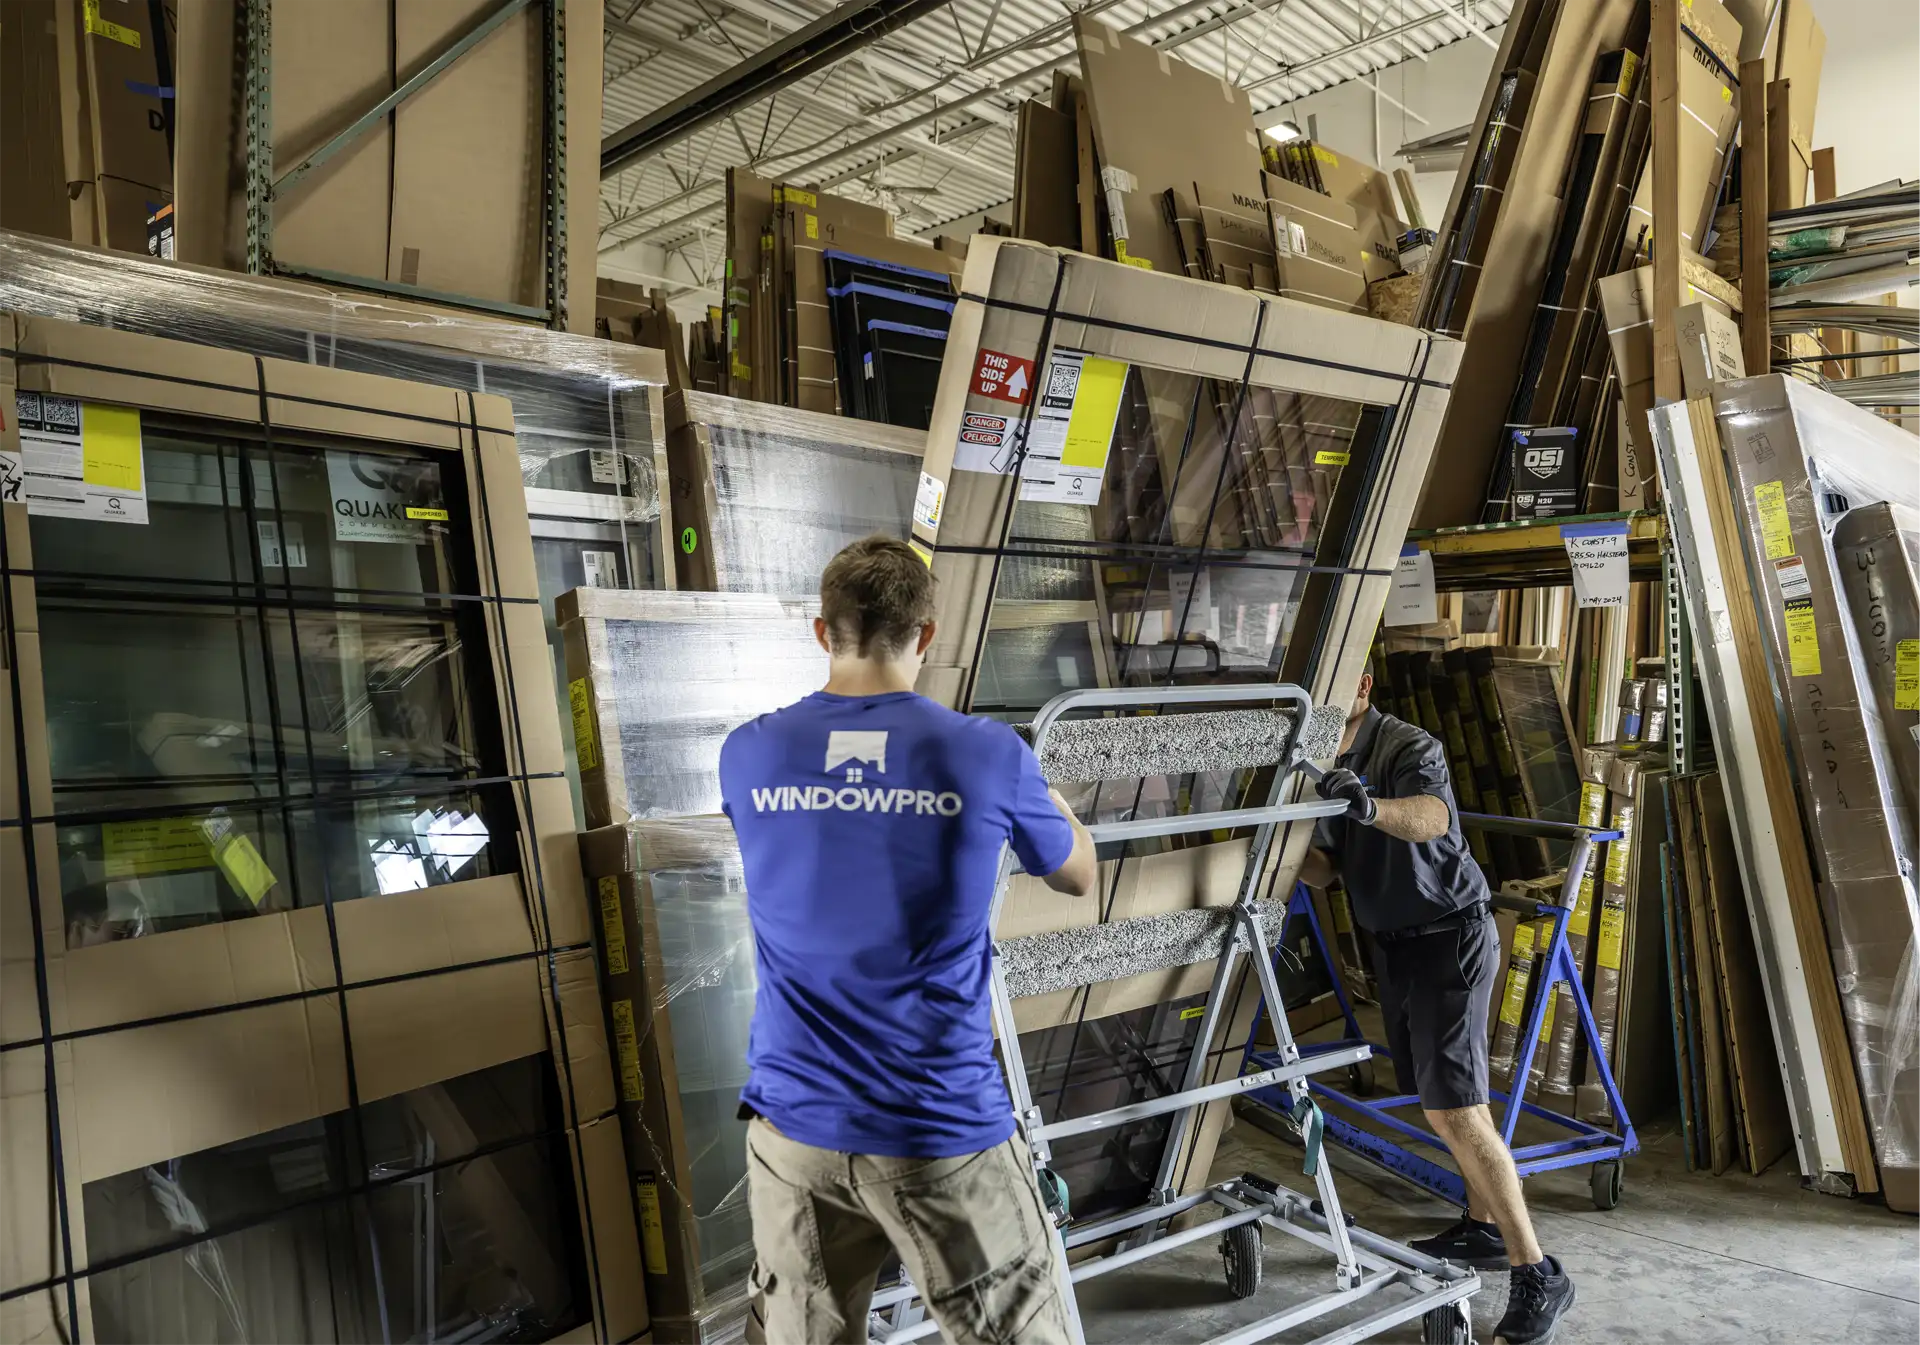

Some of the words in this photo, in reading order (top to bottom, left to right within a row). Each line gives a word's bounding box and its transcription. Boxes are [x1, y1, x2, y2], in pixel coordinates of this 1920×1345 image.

[984, 353, 1009, 369] THIS
[980, 369, 1006, 382] SIDE
[981, 381, 997, 393] UP
[970, 416, 1001, 429] DANGER
[966, 432, 998, 445] PELIGRO
[1523, 449, 1565, 468] OSI
[1516, 494, 1535, 504] OSI
[1570, 537, 1580, 549] K
[1400, 559, 1417, 567] HALL
[751, 785, 963, 817] WINDOWPRO
